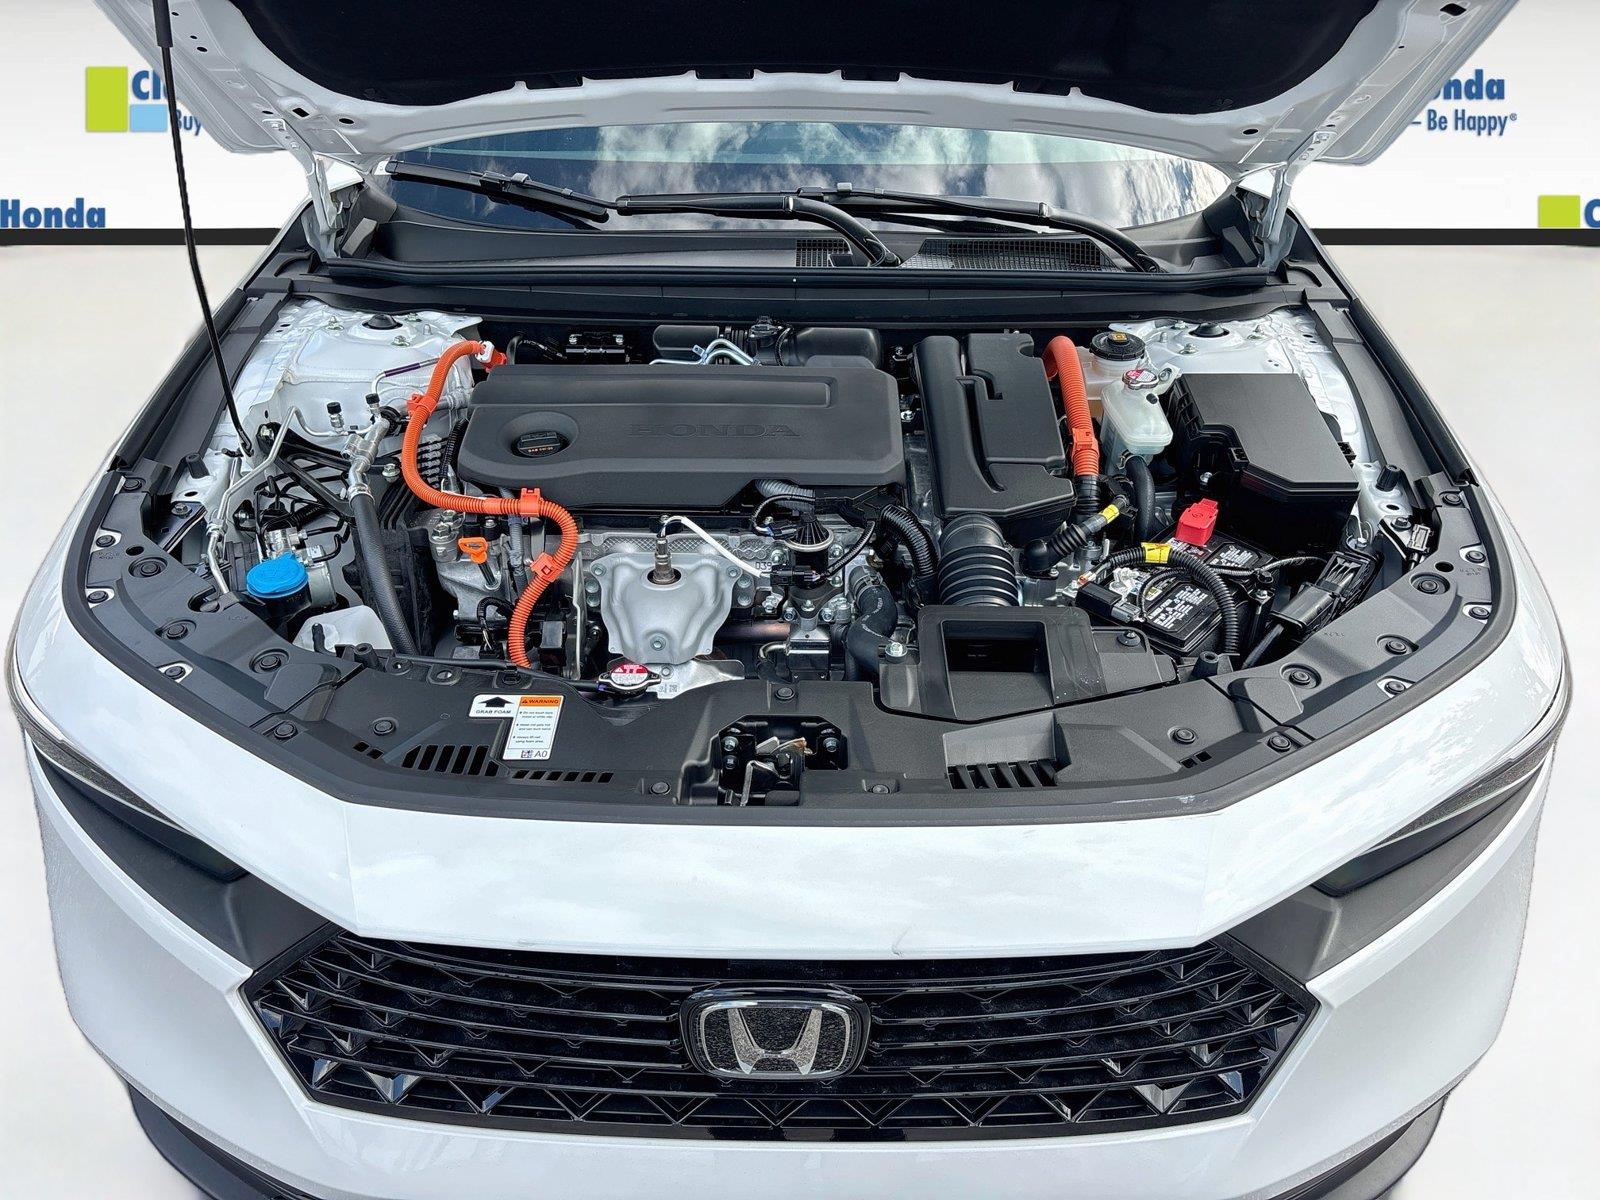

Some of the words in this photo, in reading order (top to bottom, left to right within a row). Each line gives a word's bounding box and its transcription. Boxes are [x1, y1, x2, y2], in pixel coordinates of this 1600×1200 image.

[1427, 109, 1448, 131] Be
[0, 197, 106, 228] Honda
[628, 423, 800, 438] HONDA
